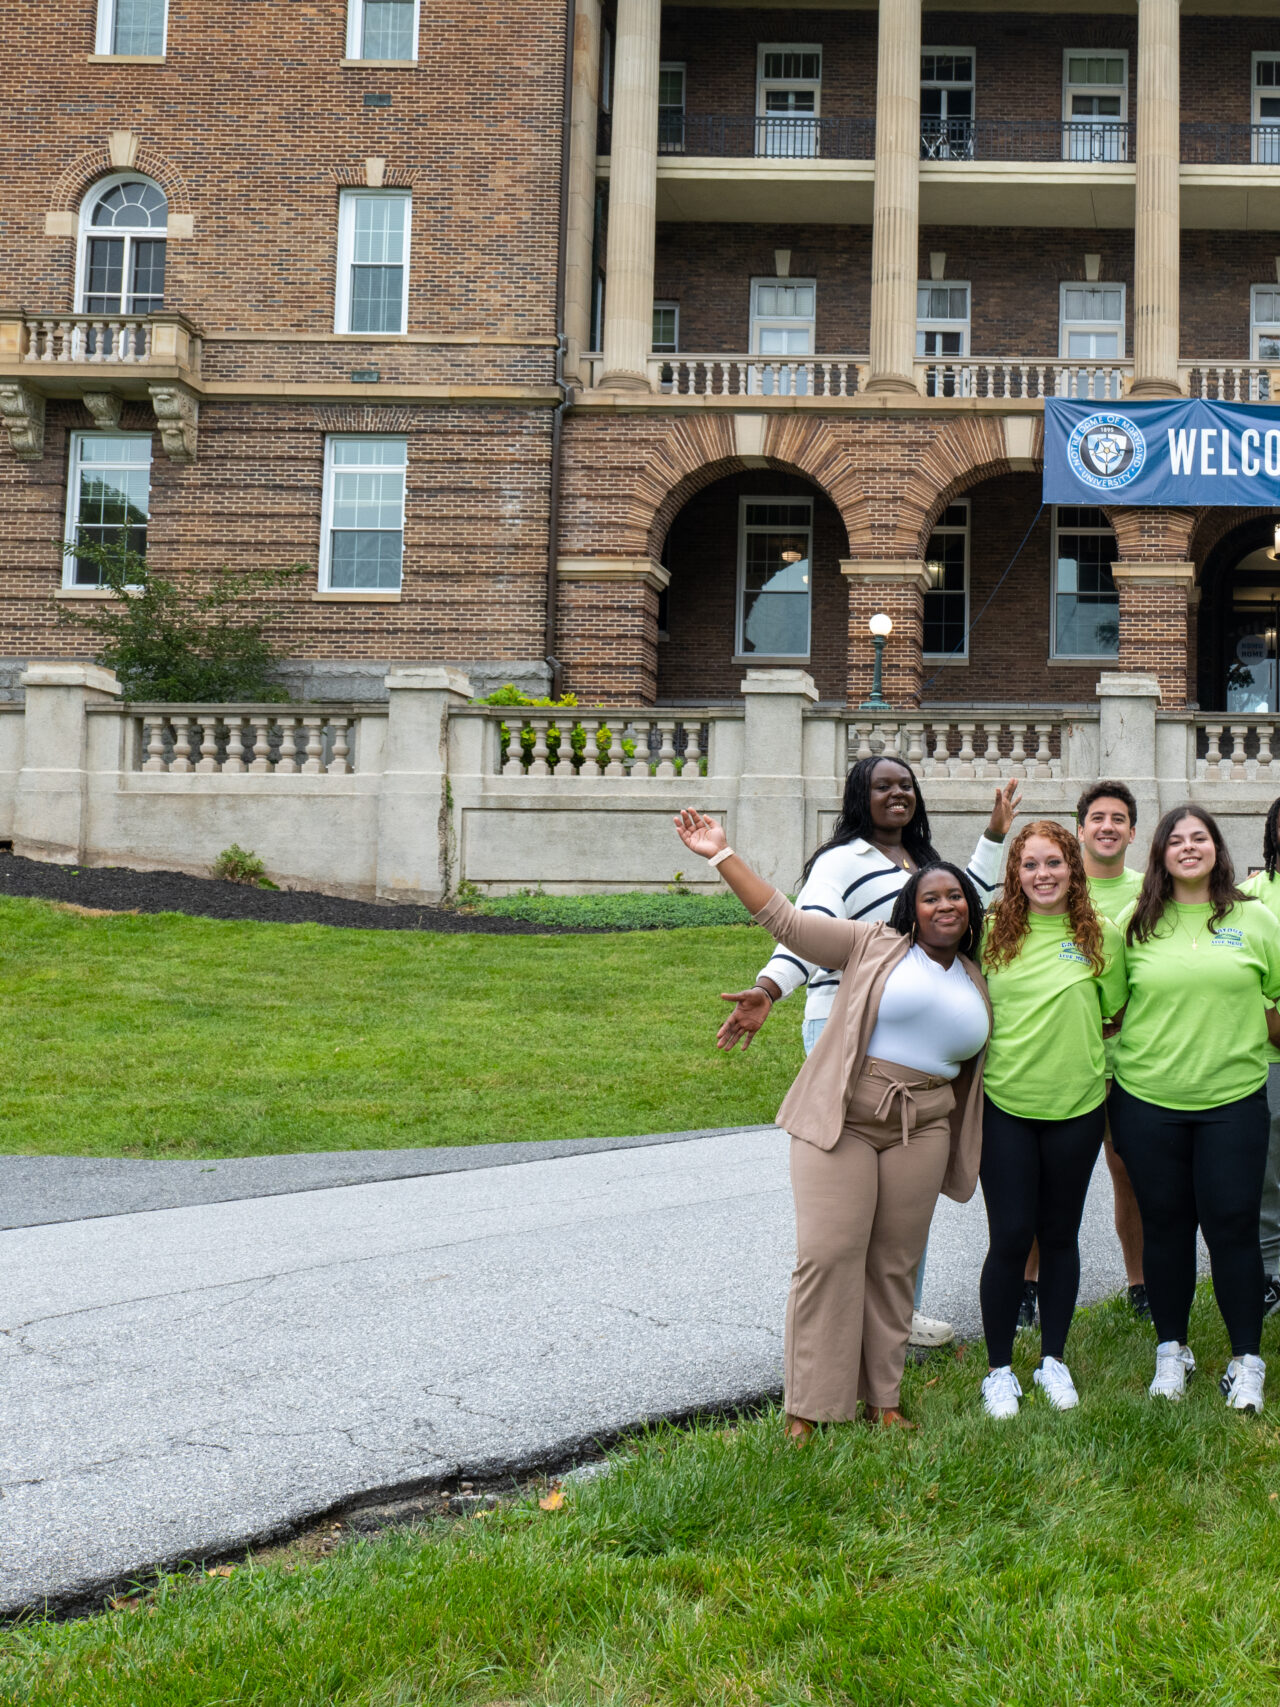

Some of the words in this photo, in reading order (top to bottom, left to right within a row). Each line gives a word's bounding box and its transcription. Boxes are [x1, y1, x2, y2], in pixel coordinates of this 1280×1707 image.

[1070, 433, 1081, 467] NOTRE
[1079, 416, 1104, 434] DAME
[1107, 415, 1121, 424] OF
[1121, 421, 1144, 468] MARYLAND
[1081, 471, 1131, 487] UNIVERSITY
